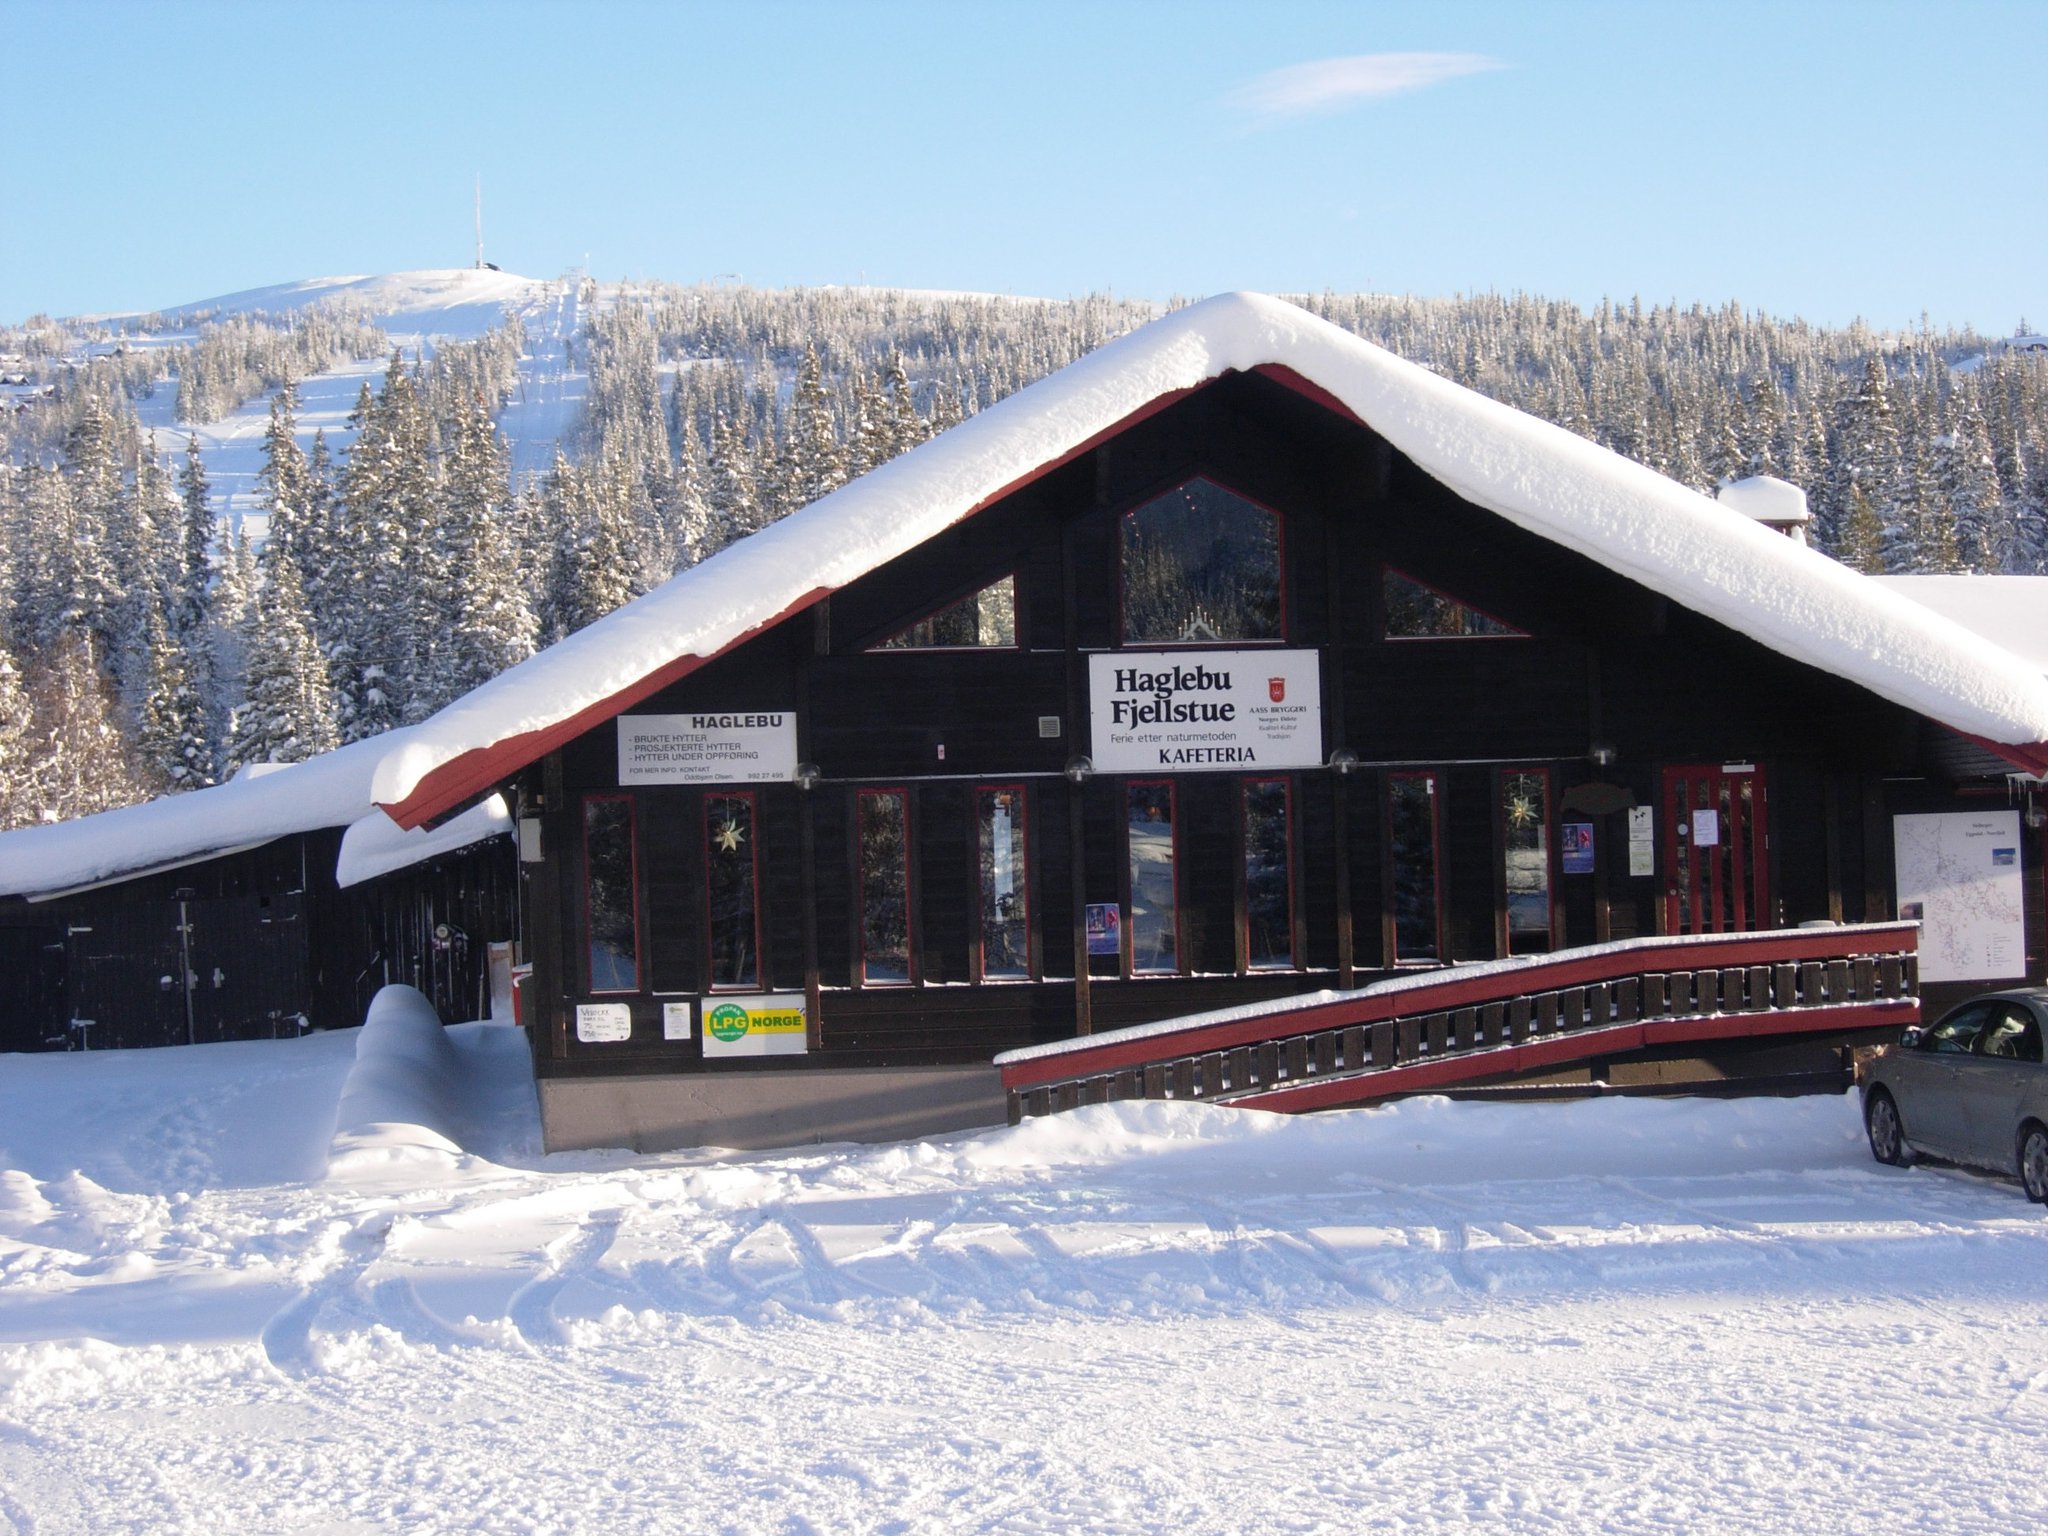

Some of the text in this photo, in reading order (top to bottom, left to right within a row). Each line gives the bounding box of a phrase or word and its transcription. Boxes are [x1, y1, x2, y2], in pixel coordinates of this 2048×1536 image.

[1114, 664, 1232, 699] Haglebu
[1110, 698, 1236, 730] Fjellstue
[1249, 705, 1307, 714] AASS BRYGGERI
[692, 715, 783, 729] HAGLEBU
[634, 734, 707, 743] BRUKTE HYTTER
[1110, 731, 1237, 744] Ferie etter naturmetoden
[634, 743, 741, 752] PROSJEKTERTE HYTTER
[634, 752, 759, 762] HYTTER UNDER OPPFØRING
[1159, 747, 1256, 764] KAFETERIA
[713, 1016, 802, 1029] LPG NORGE
